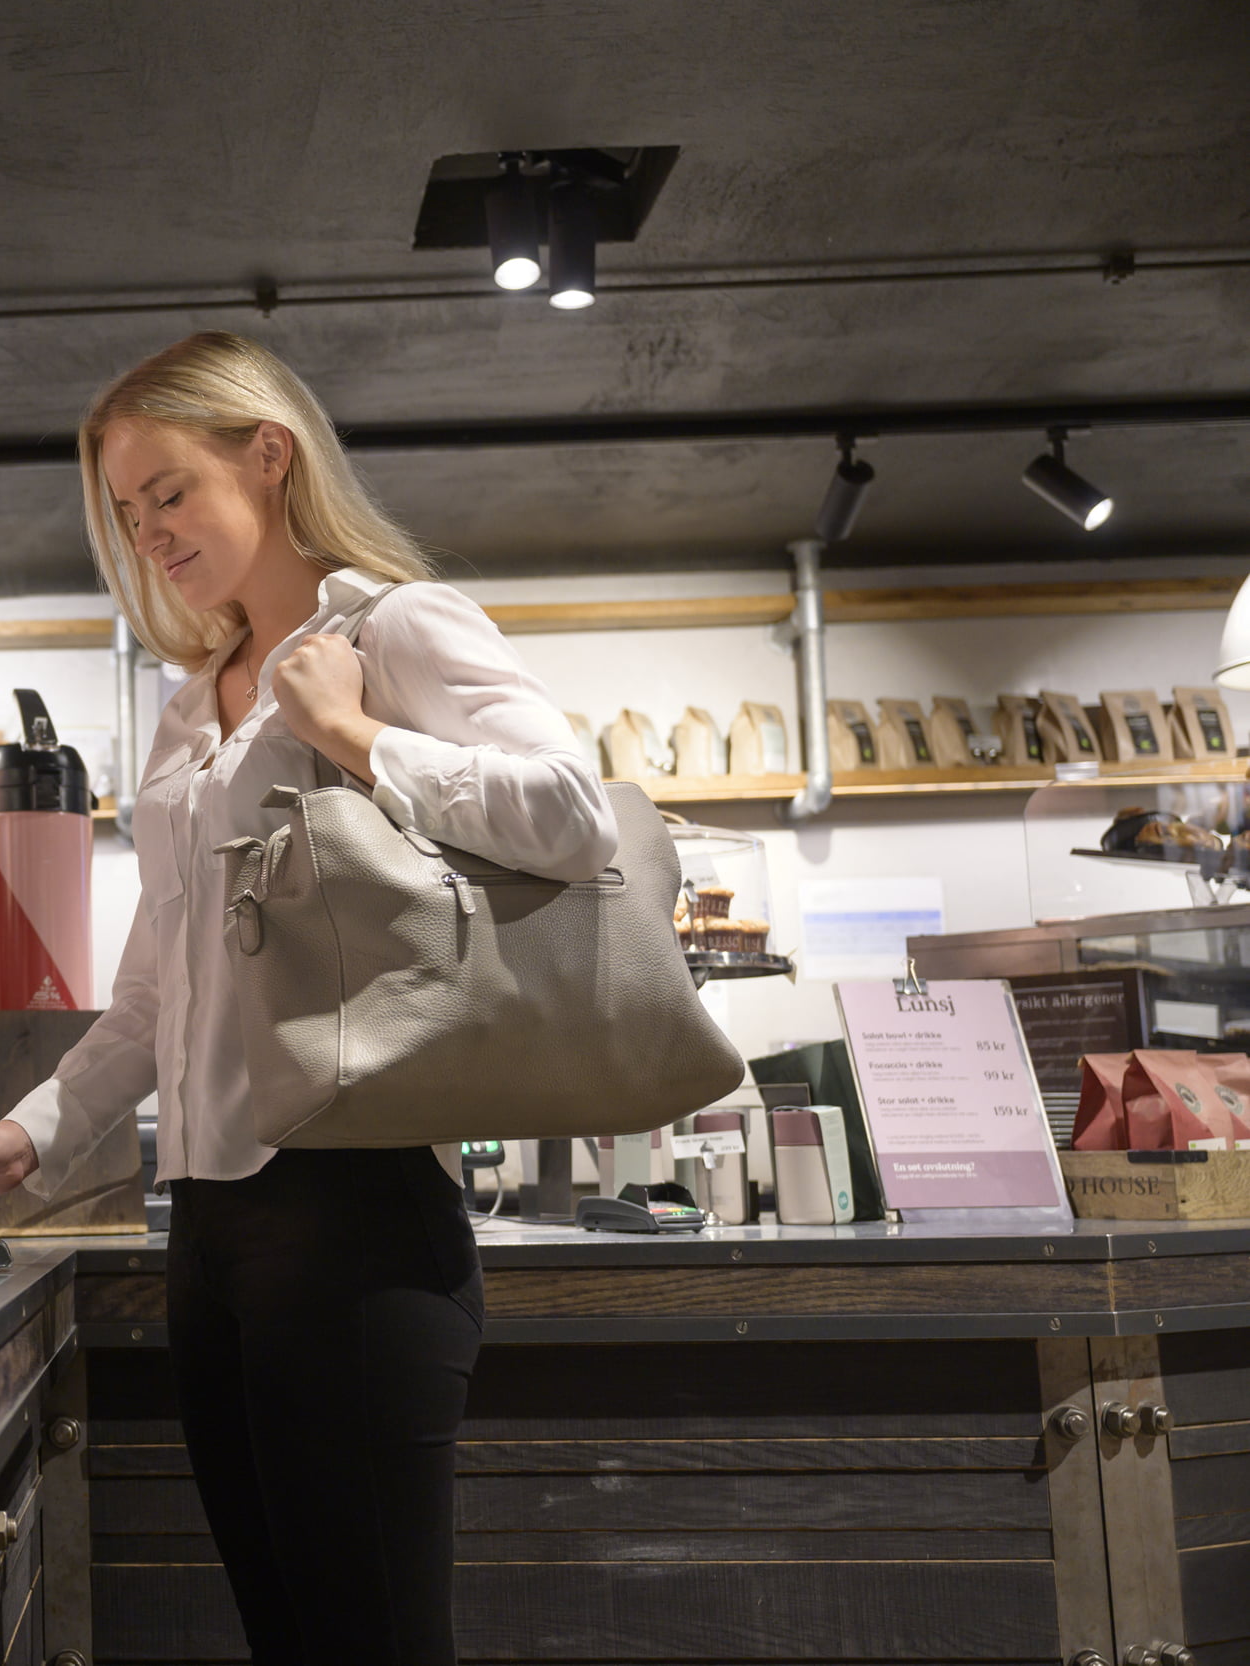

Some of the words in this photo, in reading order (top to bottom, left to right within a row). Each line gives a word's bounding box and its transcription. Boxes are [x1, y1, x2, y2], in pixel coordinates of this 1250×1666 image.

[895, 995, 956, 1016] Lunsj
[976, 1041, 991, 1051] 85
[993, 1040, 1007, 1051] kr
[983, 1071, 999, 1081] 99
[1001, 1070, 1015, 1081] kr
[993, 1106, 1013, 1117] 159
[1015, 1106, 1028, 1117] kr
[893, 1162, 906, 1172] En
[1082, 1176, 1161, 1196] HOUSE
